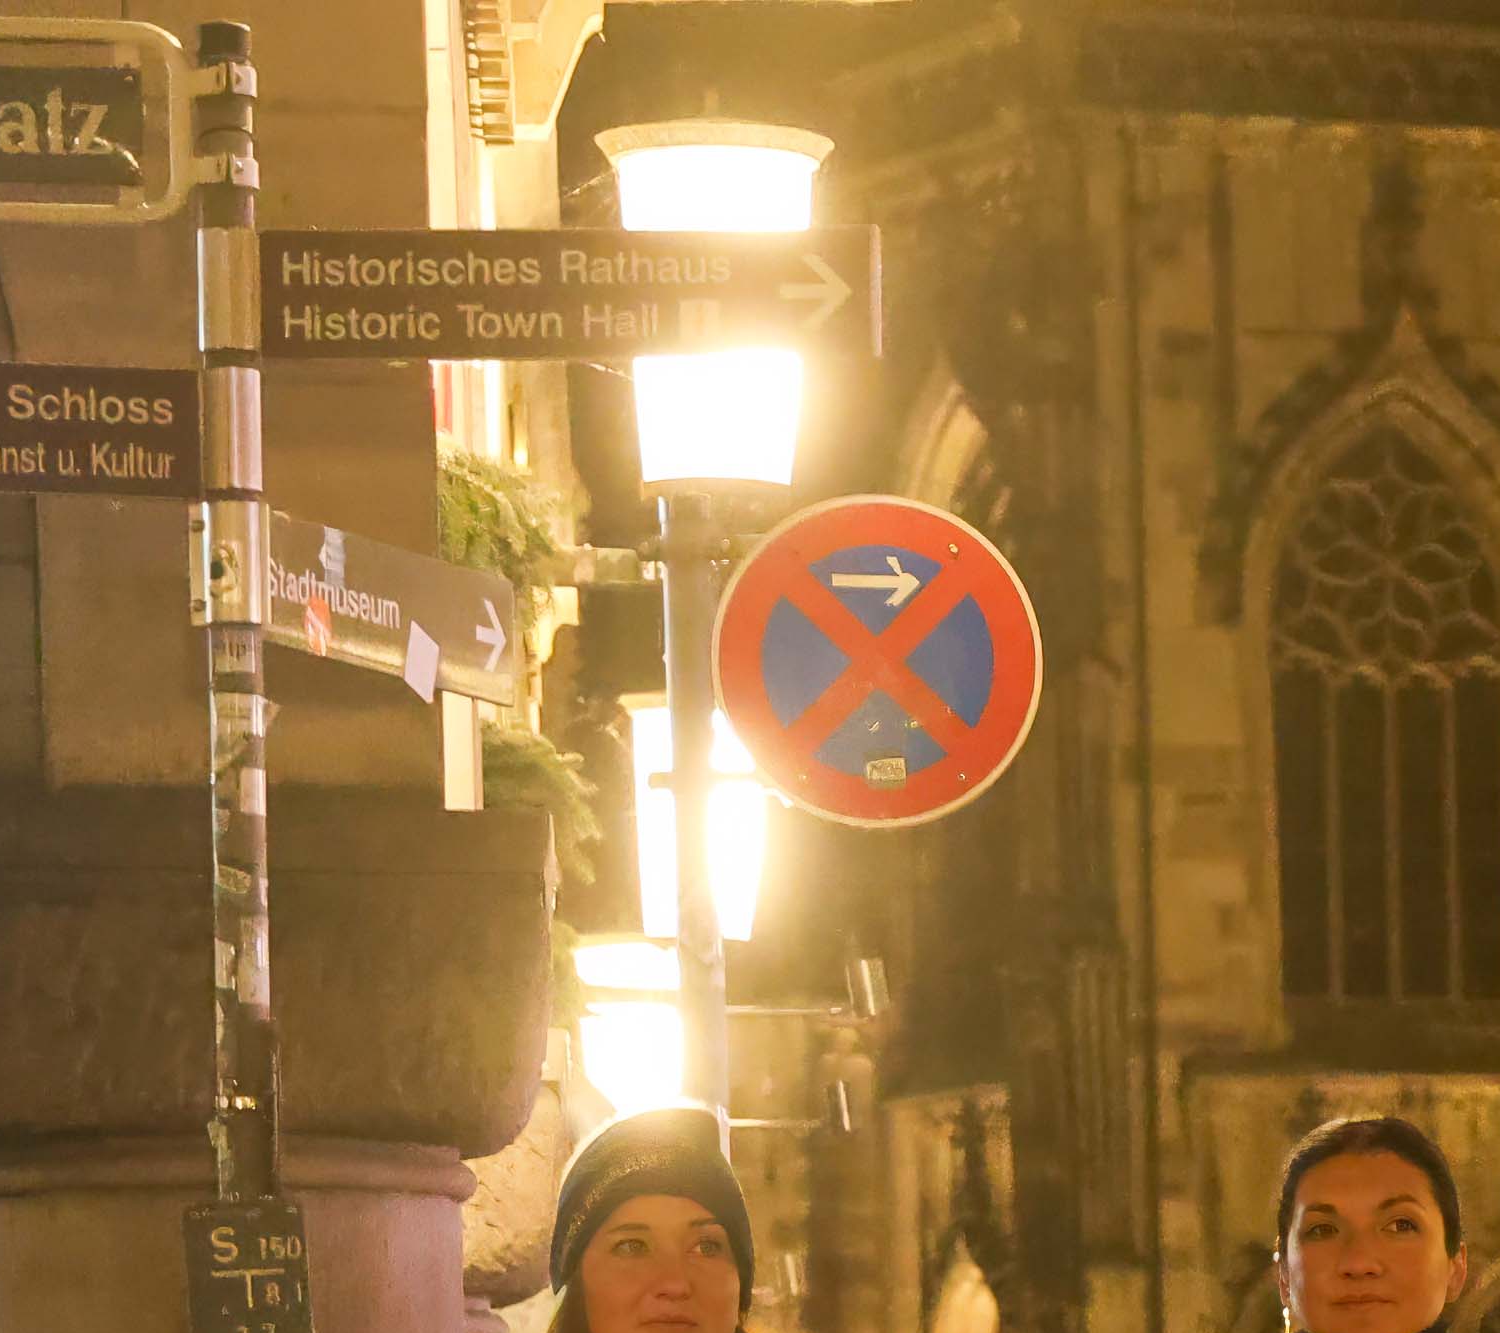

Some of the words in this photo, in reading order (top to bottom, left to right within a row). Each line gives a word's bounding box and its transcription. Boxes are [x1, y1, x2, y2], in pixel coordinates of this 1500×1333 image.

[281, 249, 541, 287] Historisches
[559, 249, 731, 285] Rathaus
[282, 305, 440, 341] Historic
[457, 303, 563, 340] Town
[581, 303, 658, 337] Hall
[6, 384, 173, 424] Schloss
[57, 447, 81, 477] u.
[91, 441, 175, 480] Kultur
[268, 556, 401, 630] Stadtmuseum
[211, 1226, 239, 1264] S
